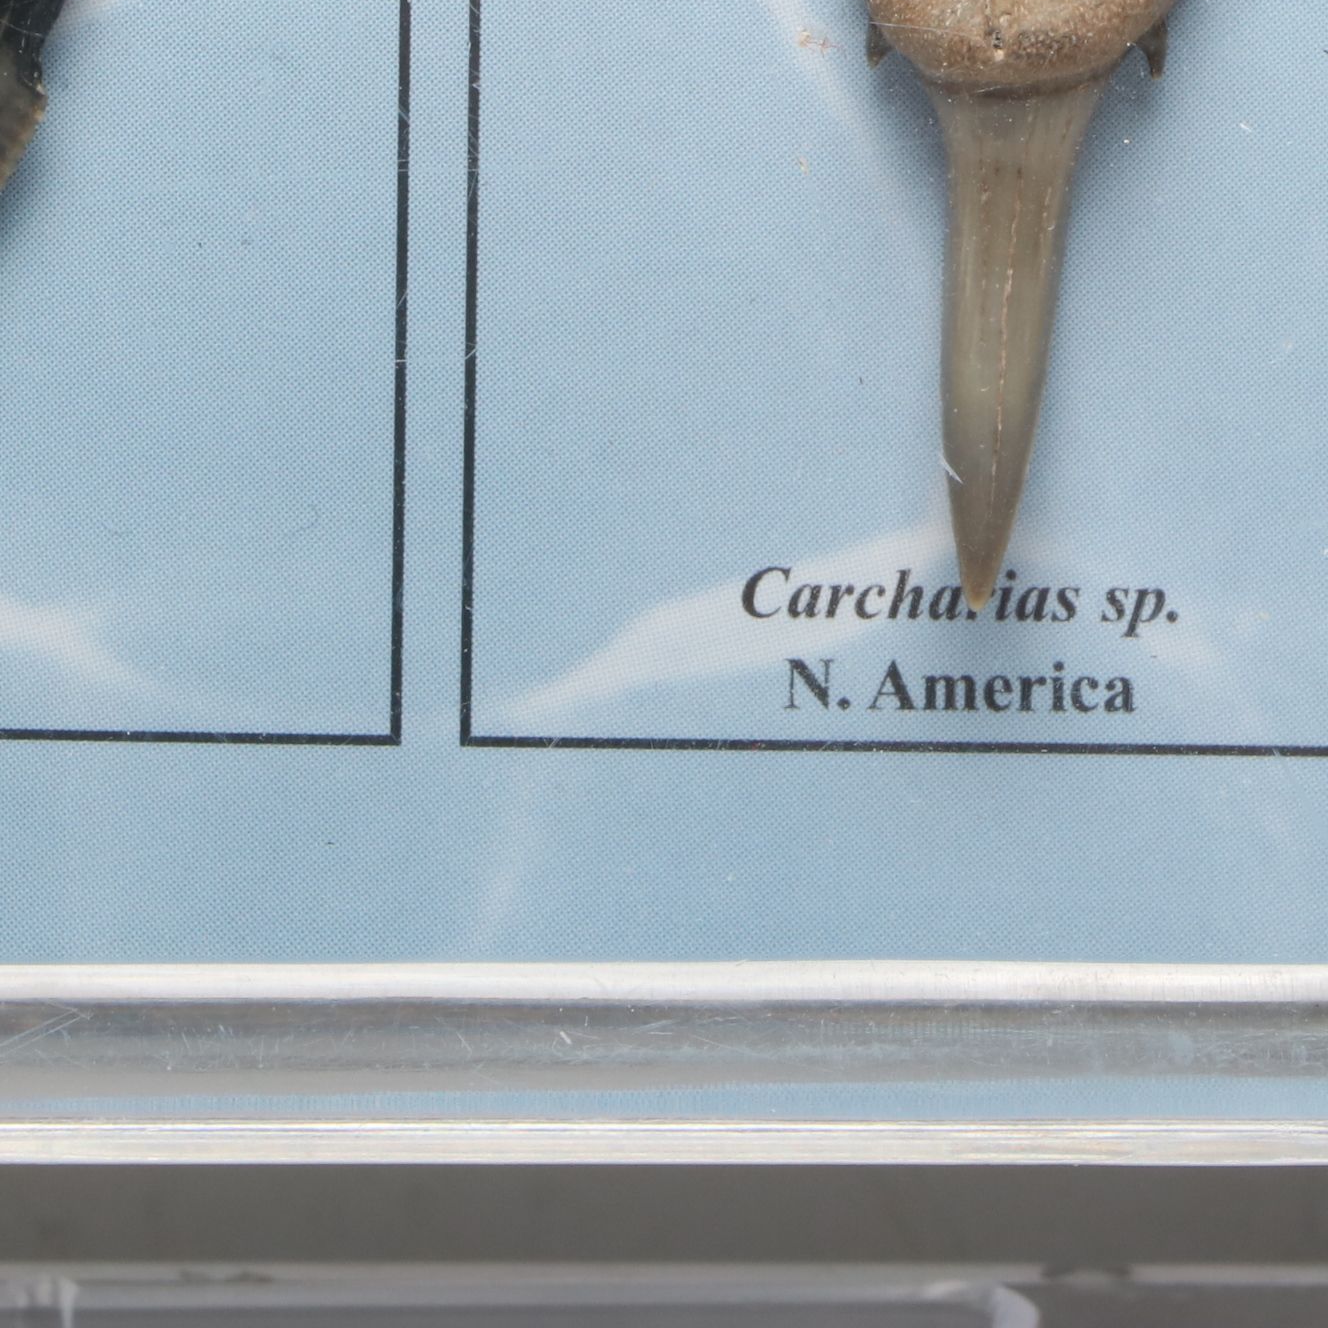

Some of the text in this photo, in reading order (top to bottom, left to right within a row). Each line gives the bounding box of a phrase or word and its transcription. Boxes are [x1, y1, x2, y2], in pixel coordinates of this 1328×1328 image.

[740, 564, 1180, 639] Carchaias sp.
[784, 657, 1136, 714] N. America
